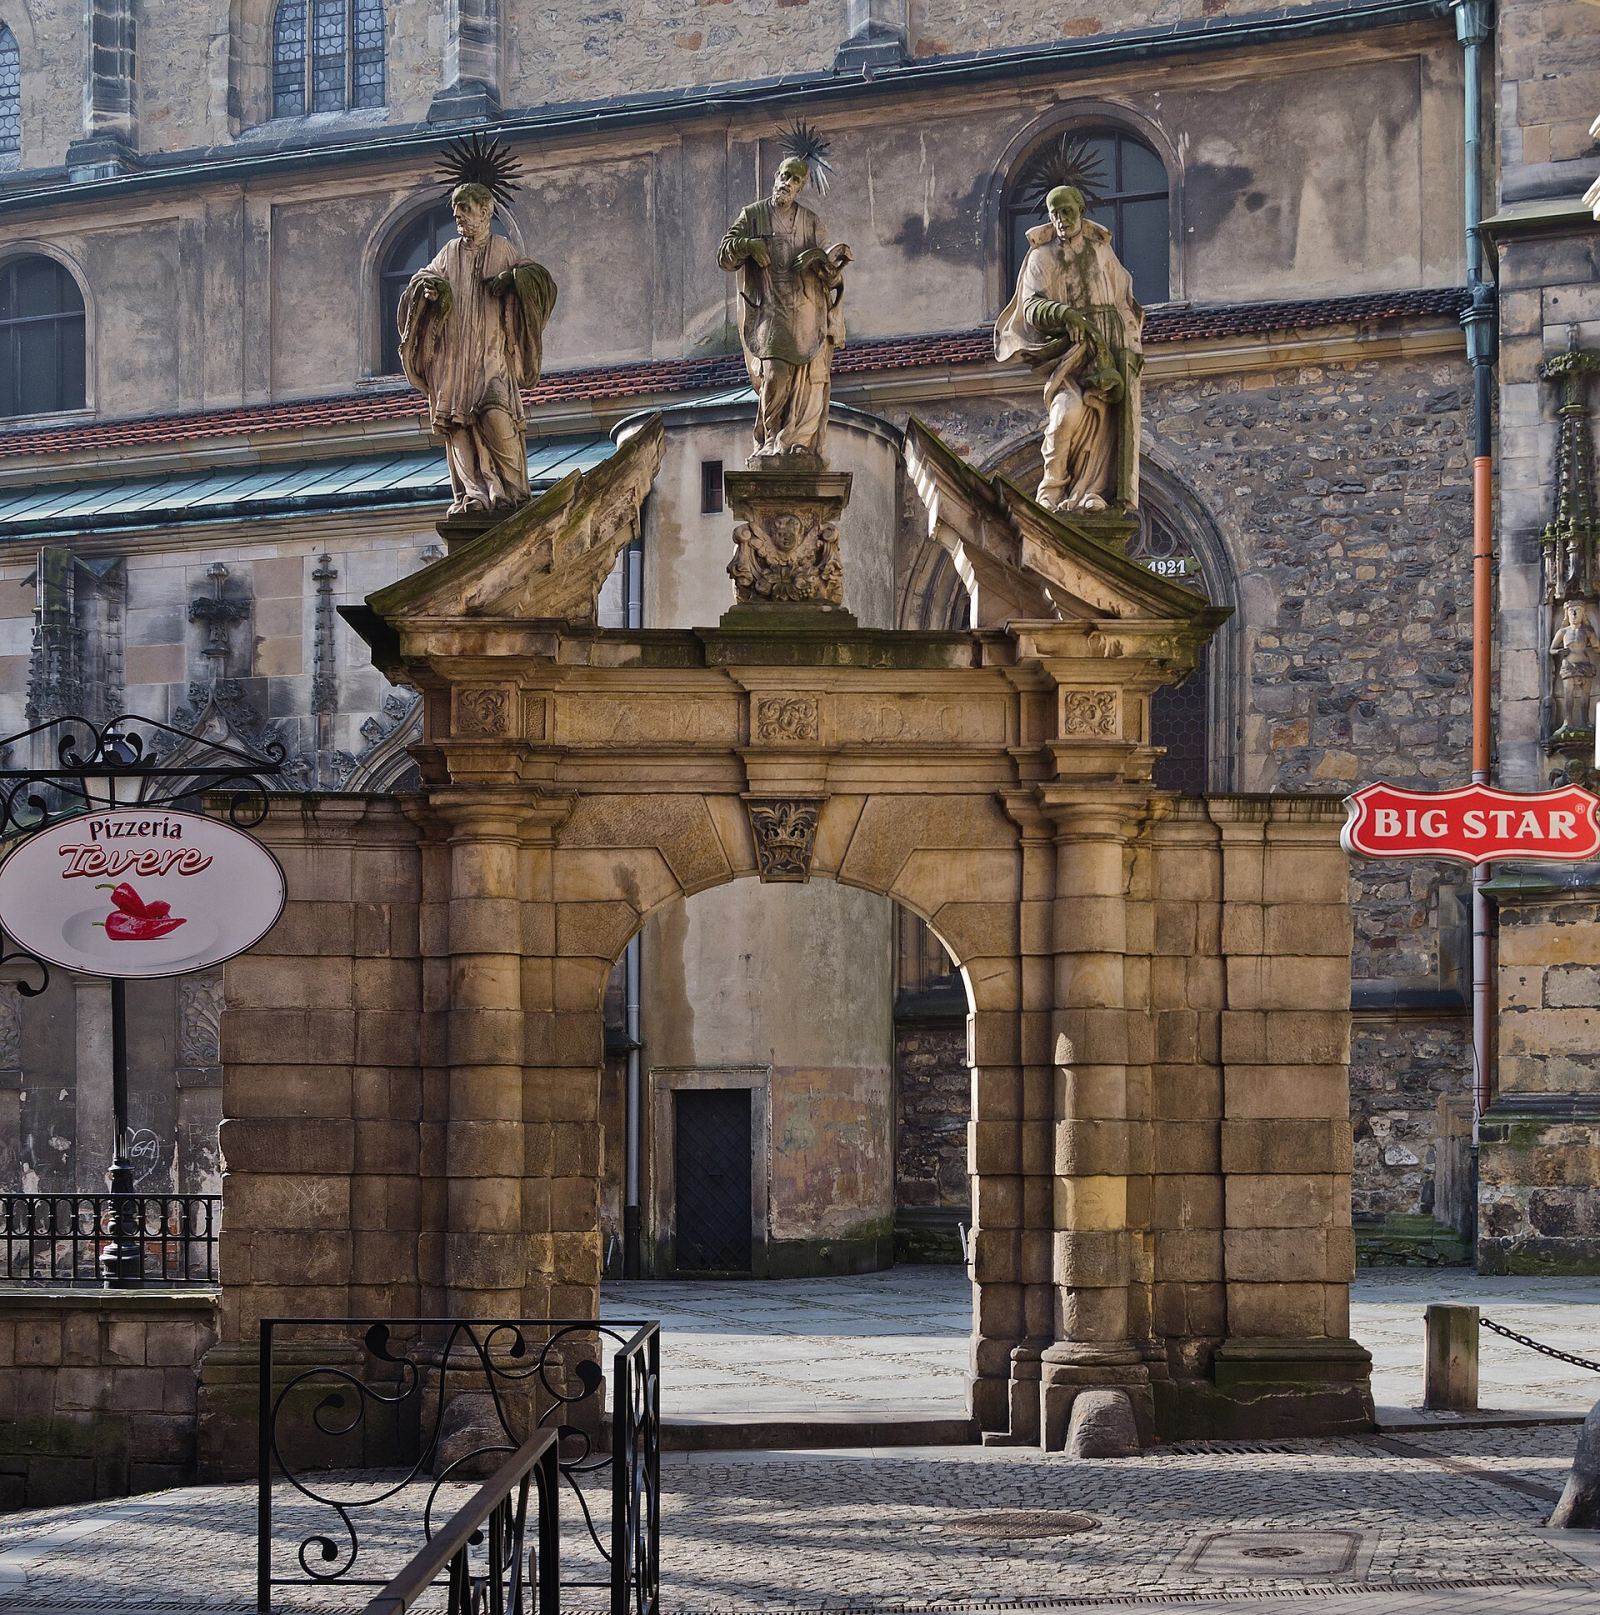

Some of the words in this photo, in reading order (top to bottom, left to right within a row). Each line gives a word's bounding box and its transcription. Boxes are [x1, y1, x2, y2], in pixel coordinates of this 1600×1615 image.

[1147, 559, 1186, 575] 1921
[89, 817, 182, 840] Pizzeria
[1374, 809, 1449, 838] BIG
[1462, 810, 1578, 840] STAR
[59, 844, 213, 878] Tevere
